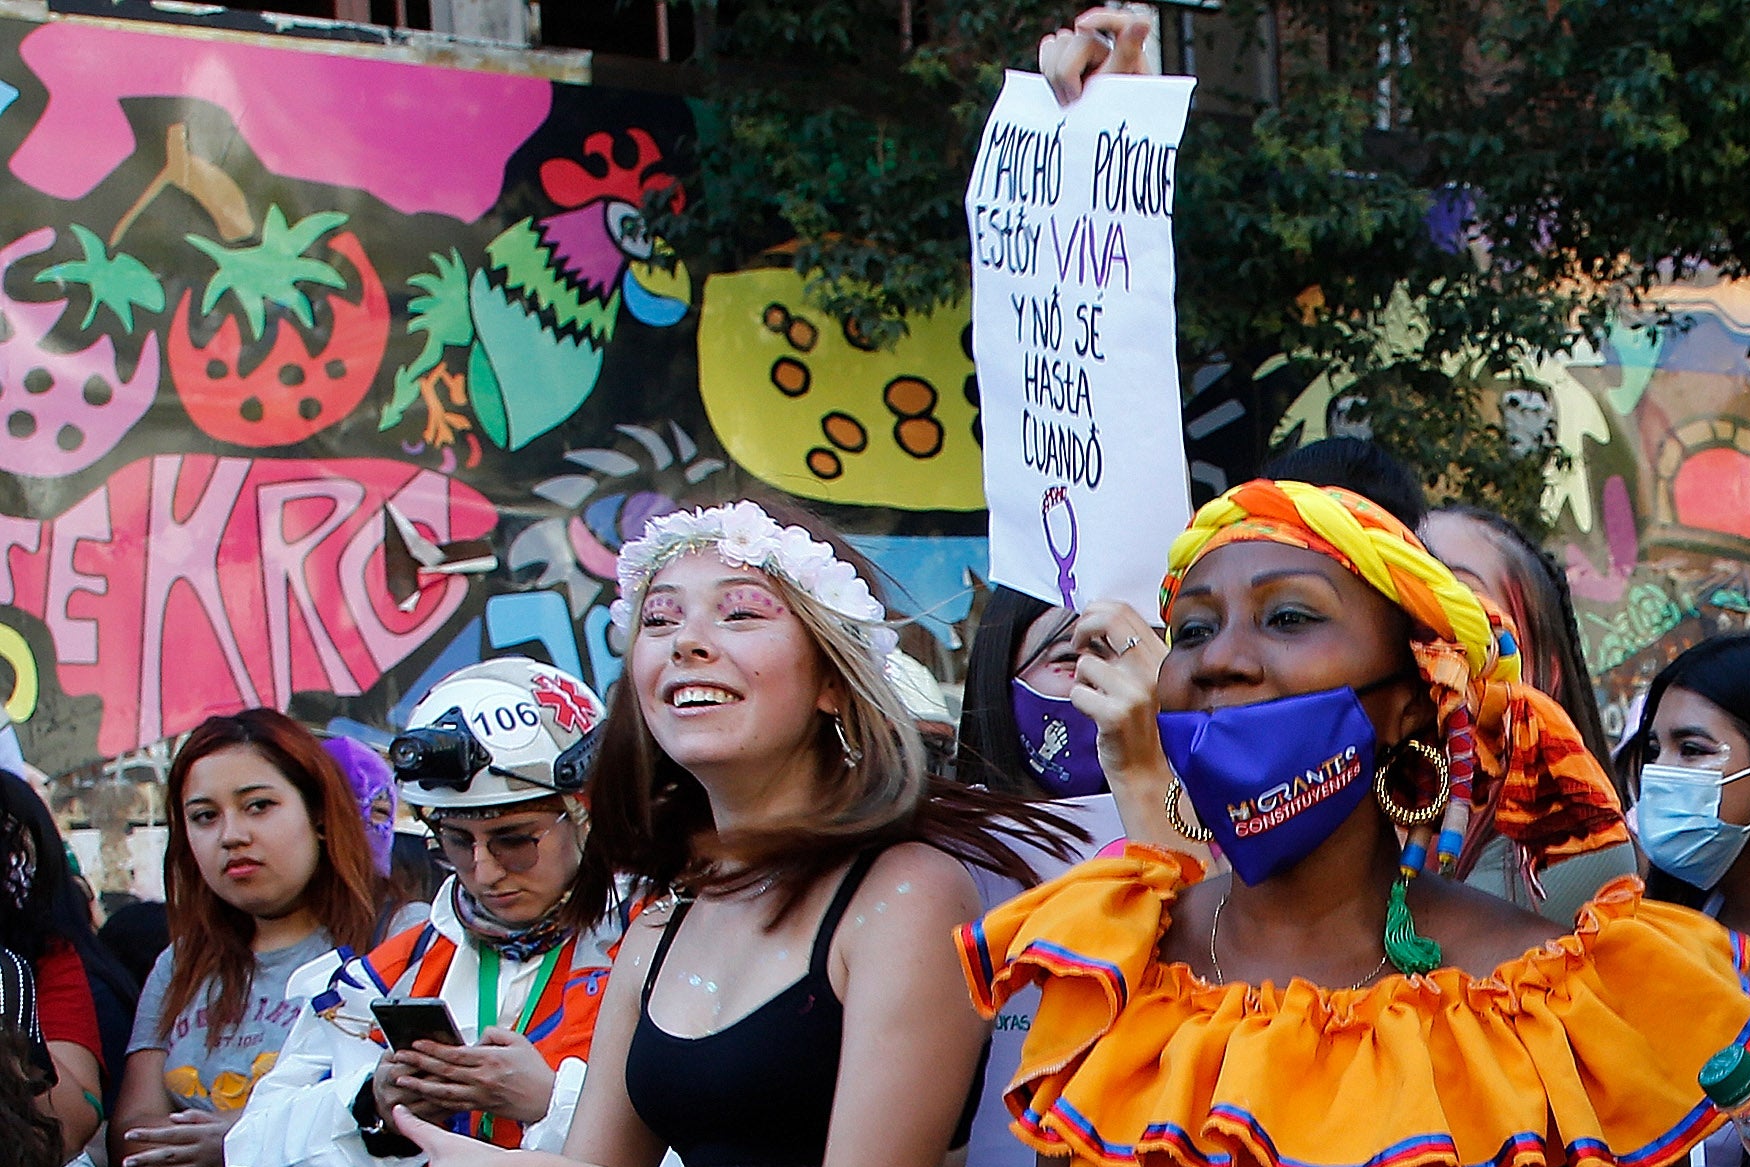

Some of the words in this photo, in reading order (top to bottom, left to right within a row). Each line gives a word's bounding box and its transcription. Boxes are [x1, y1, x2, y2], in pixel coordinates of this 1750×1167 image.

[472, 702, 539, 737] 106
[1227, 746, 1357, 823] MIGRANTES
[1235, 762, 1361, 837] CONSTITUYENTES
